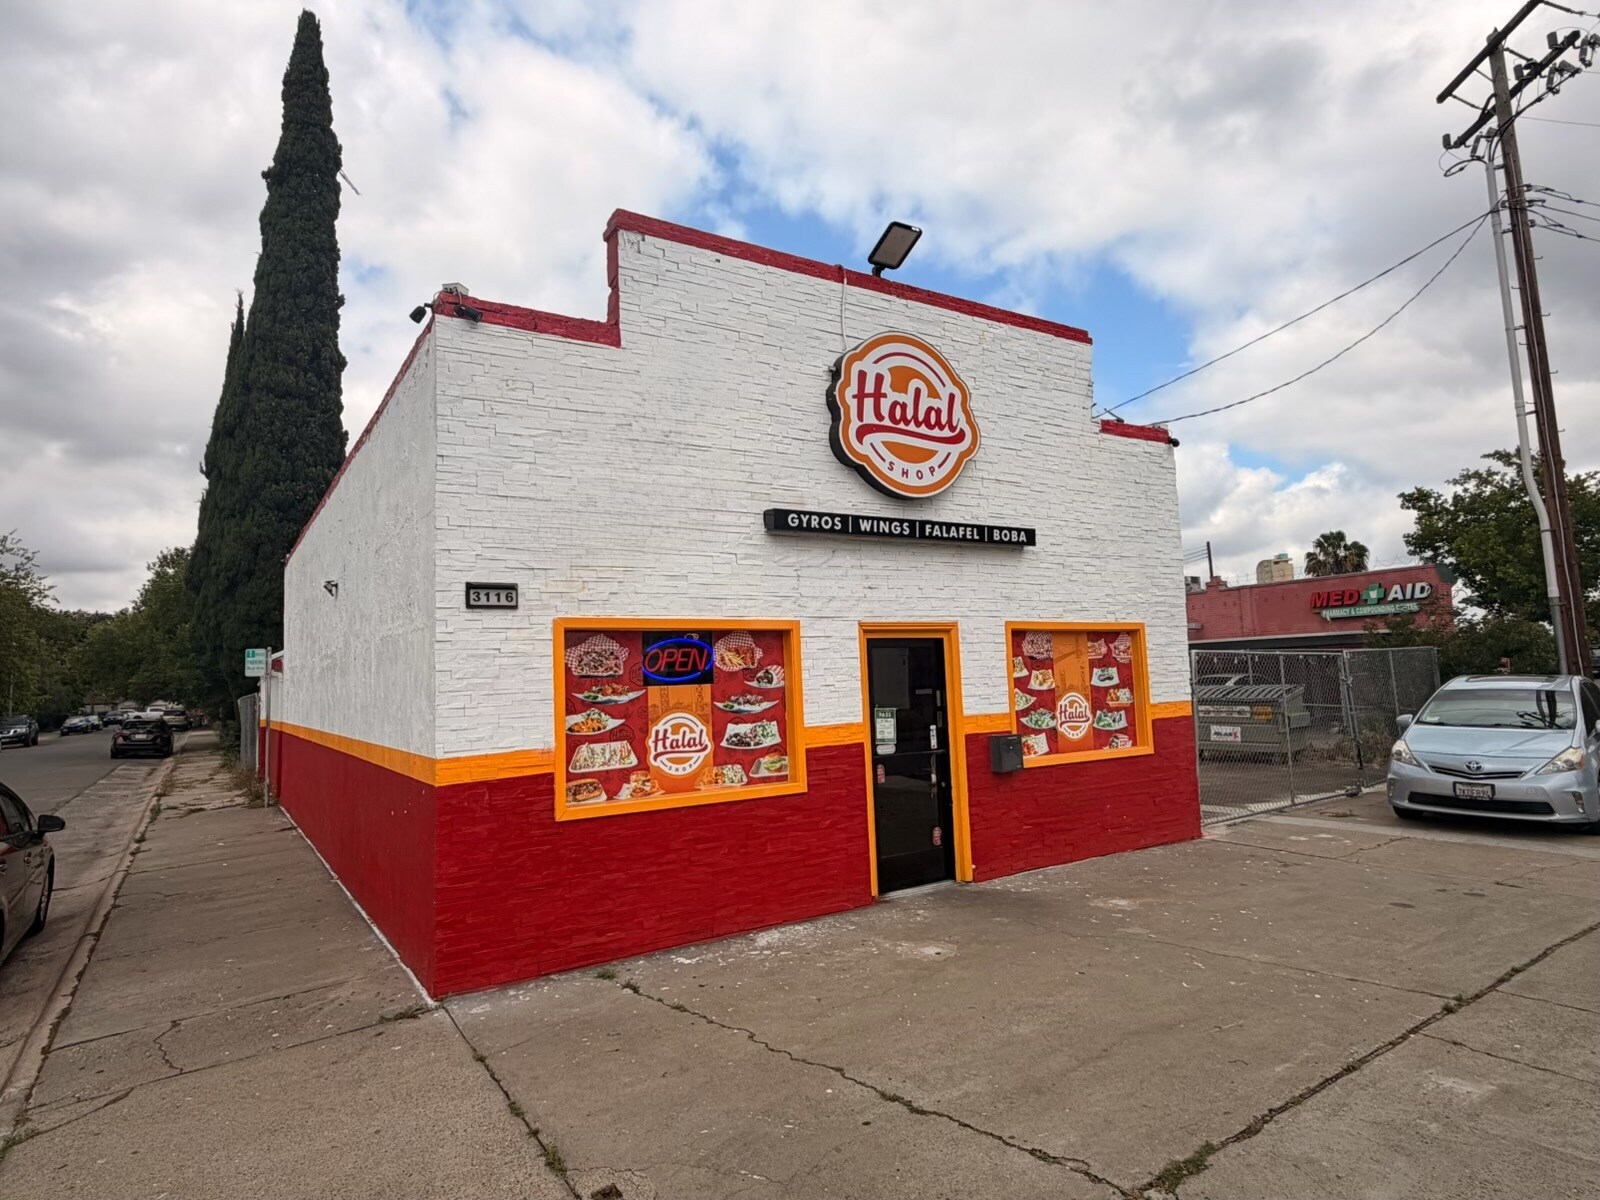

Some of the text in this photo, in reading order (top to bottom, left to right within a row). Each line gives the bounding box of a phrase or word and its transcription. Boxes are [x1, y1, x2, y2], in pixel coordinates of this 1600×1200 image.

[852, 369, 960, 433] Halal
[887, 461, 936, 480] SHOP
[787, 513, 1027, 543] GYROS WINGS FALAFEL BOBA
[472, 591, 514, 603] 3116
[1310, 582, 1432, 608] MED AID
[1322, 608, 1350, 617] PHARMACY
[1356, 604, 1396, 614] COMPOUNDING
[645, 649, 708, 672] OPEN
[1058, 703, 1089, 720] Halal
[652, 728, 705, 752] Halal
[668, 763, 694, 772] SHOP
